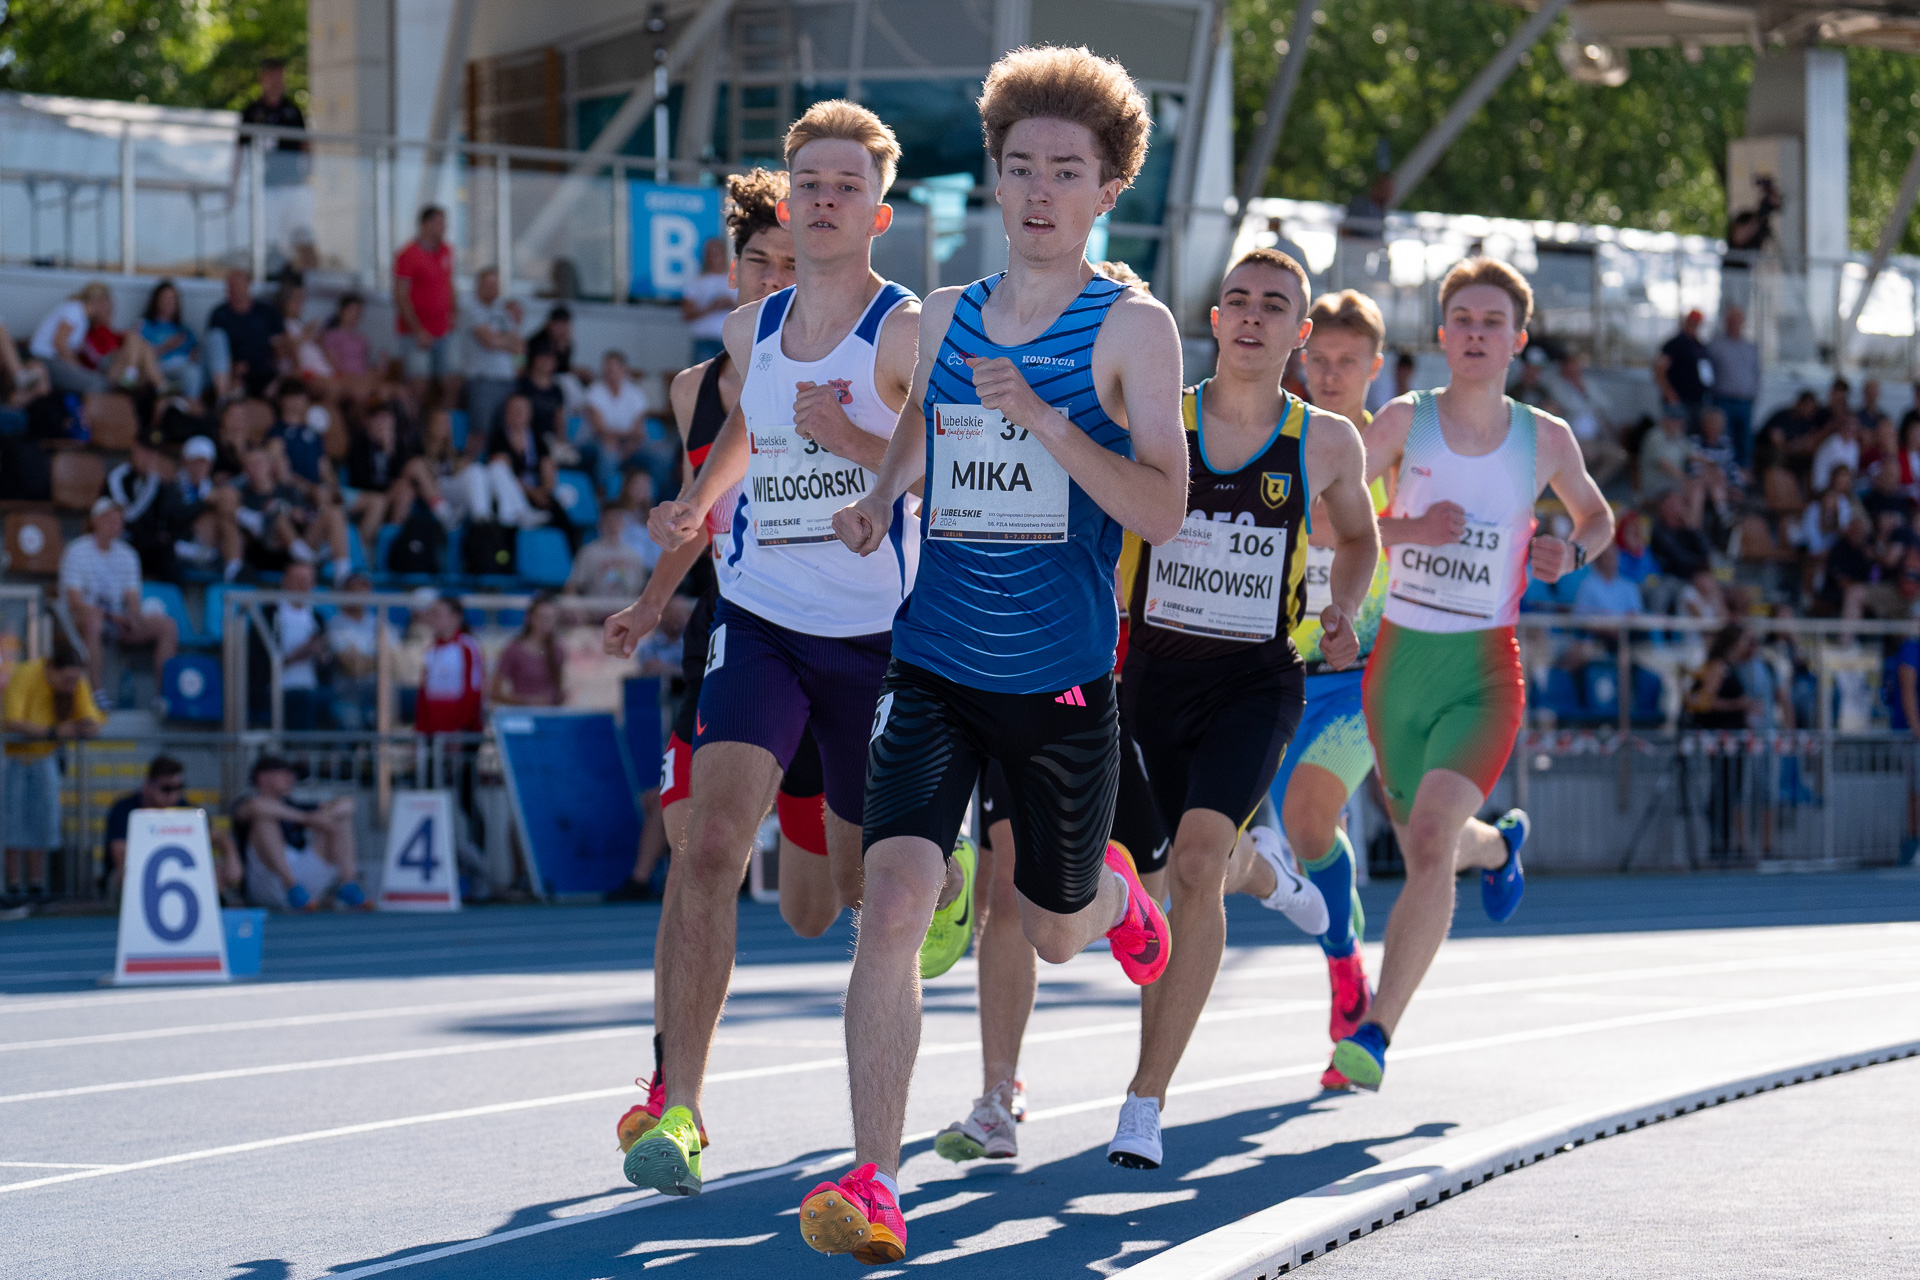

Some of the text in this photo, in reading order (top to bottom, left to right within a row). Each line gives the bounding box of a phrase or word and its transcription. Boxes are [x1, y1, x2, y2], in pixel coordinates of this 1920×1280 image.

[651, 214, 699, 290] B
[1022, 356, 1075, 367] KONDYCJA
[753, 467, 866, 503] WIELOGÓRSKI
[951, 460, 1033, 491] MIKA
[760, 518, 801, 527] LUBELSKIE
[940, 518, 957, 527] 2024
[941, 508, 982, 518] LUBELSKIE
[760, 528, 779, 536] 2024
[1229, 532, 1274, 557] 106
[1156, 559, 1273, 600] MIZIKOWSKI
[1402, 549, 1490, 585] CHOINA
[1161, 608, 1180, 618] 2024
[1162, 600, 1204, 615] LUBELSKIE
[399, 814, 439, 882] 4
[143, 844, 201, 943] 6
